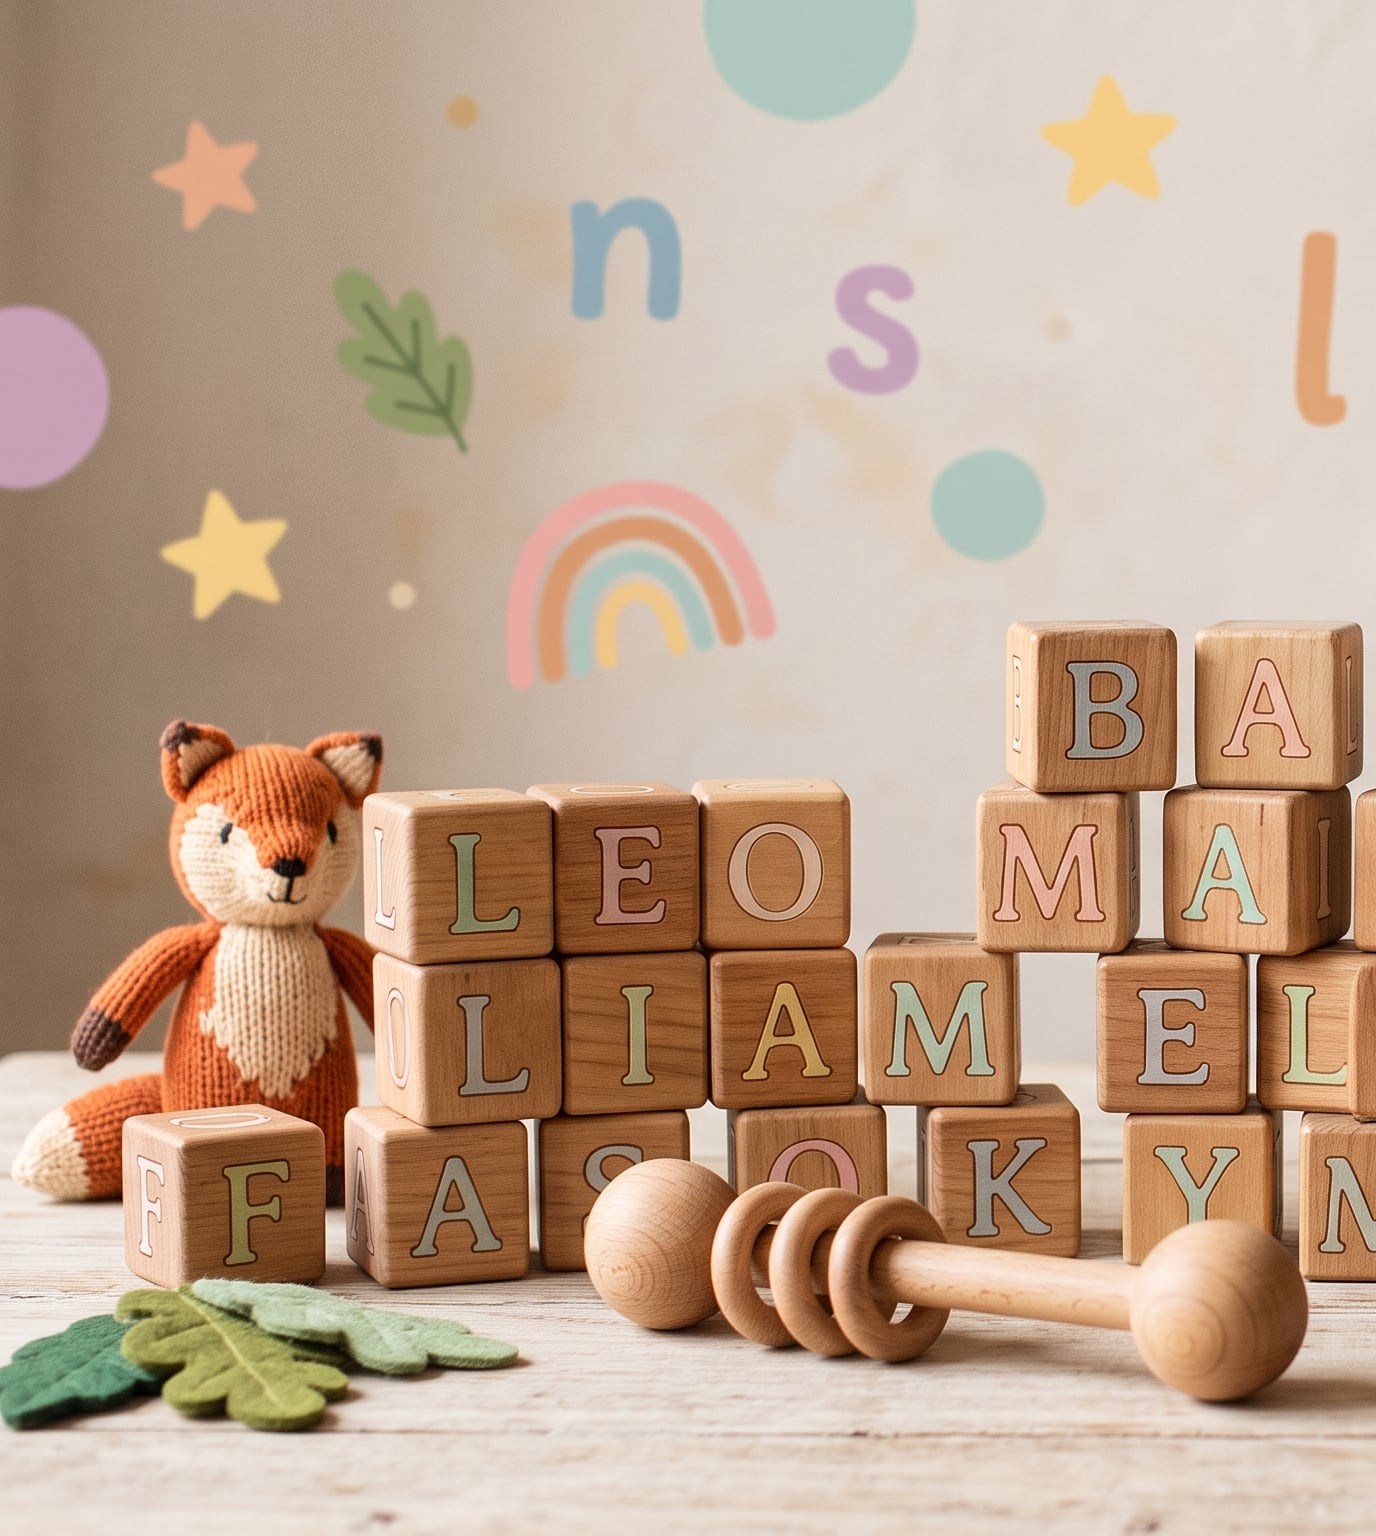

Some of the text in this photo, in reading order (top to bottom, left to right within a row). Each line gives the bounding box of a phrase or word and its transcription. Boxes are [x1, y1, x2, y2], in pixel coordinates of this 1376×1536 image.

[570, 196, 683, 322] n
[827, 264, 921, 396] s
[448, 821, 825, 935] LEO
[457, 980, 996, 1097] LIAM
[221, 1158, 291, 1268] F
